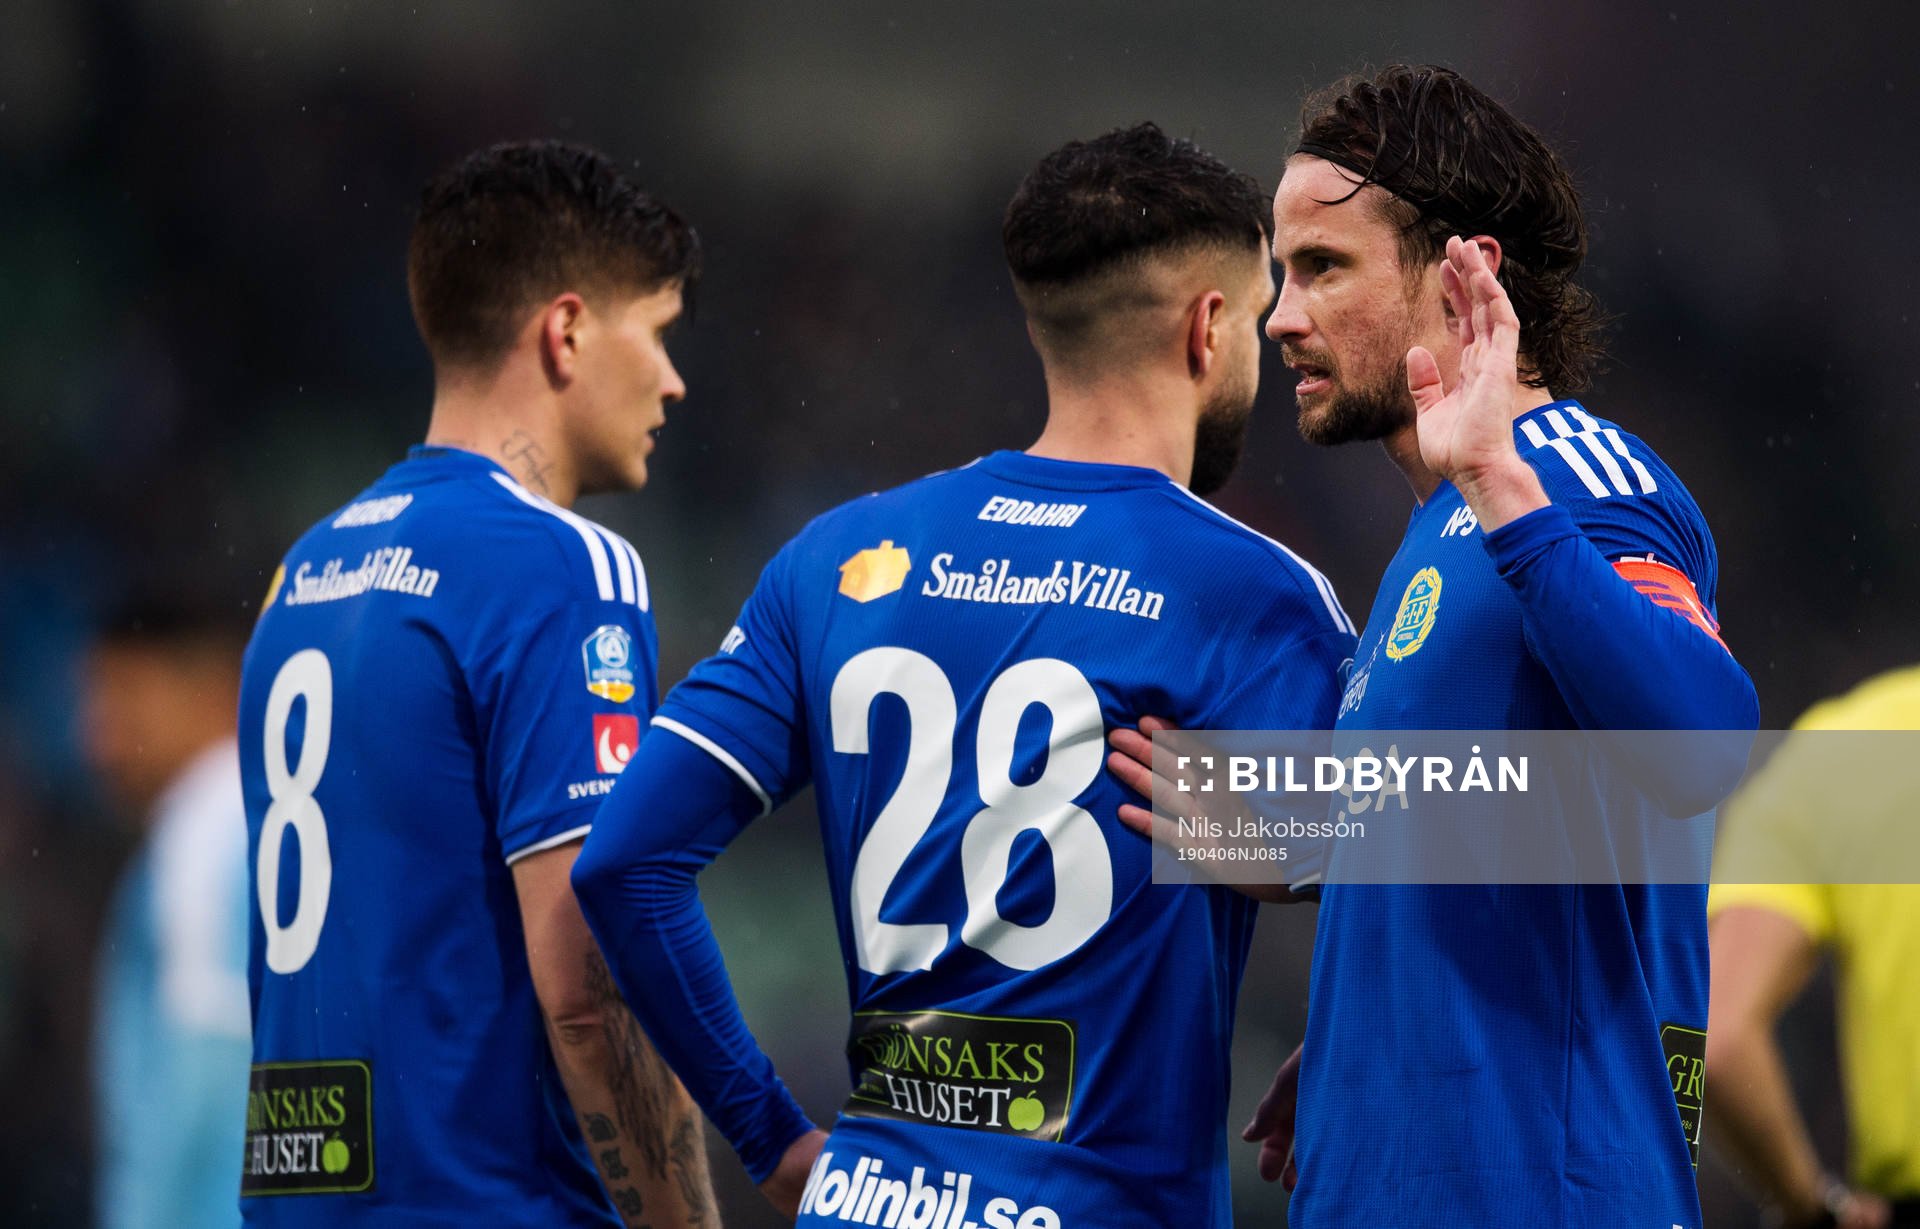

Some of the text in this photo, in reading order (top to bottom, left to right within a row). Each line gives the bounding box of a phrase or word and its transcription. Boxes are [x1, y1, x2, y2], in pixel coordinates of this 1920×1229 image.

[977, 495, 1087, 528] EDDAHRI
[921, 552, 1165, 621] SmålandsVillan
[258, 649, 333, 974] 8
[830, 646, 1114, 976] 28
[885, 1073, 1011, 1127] HUSET
[250, 1131, 325, 1176] HUSET
